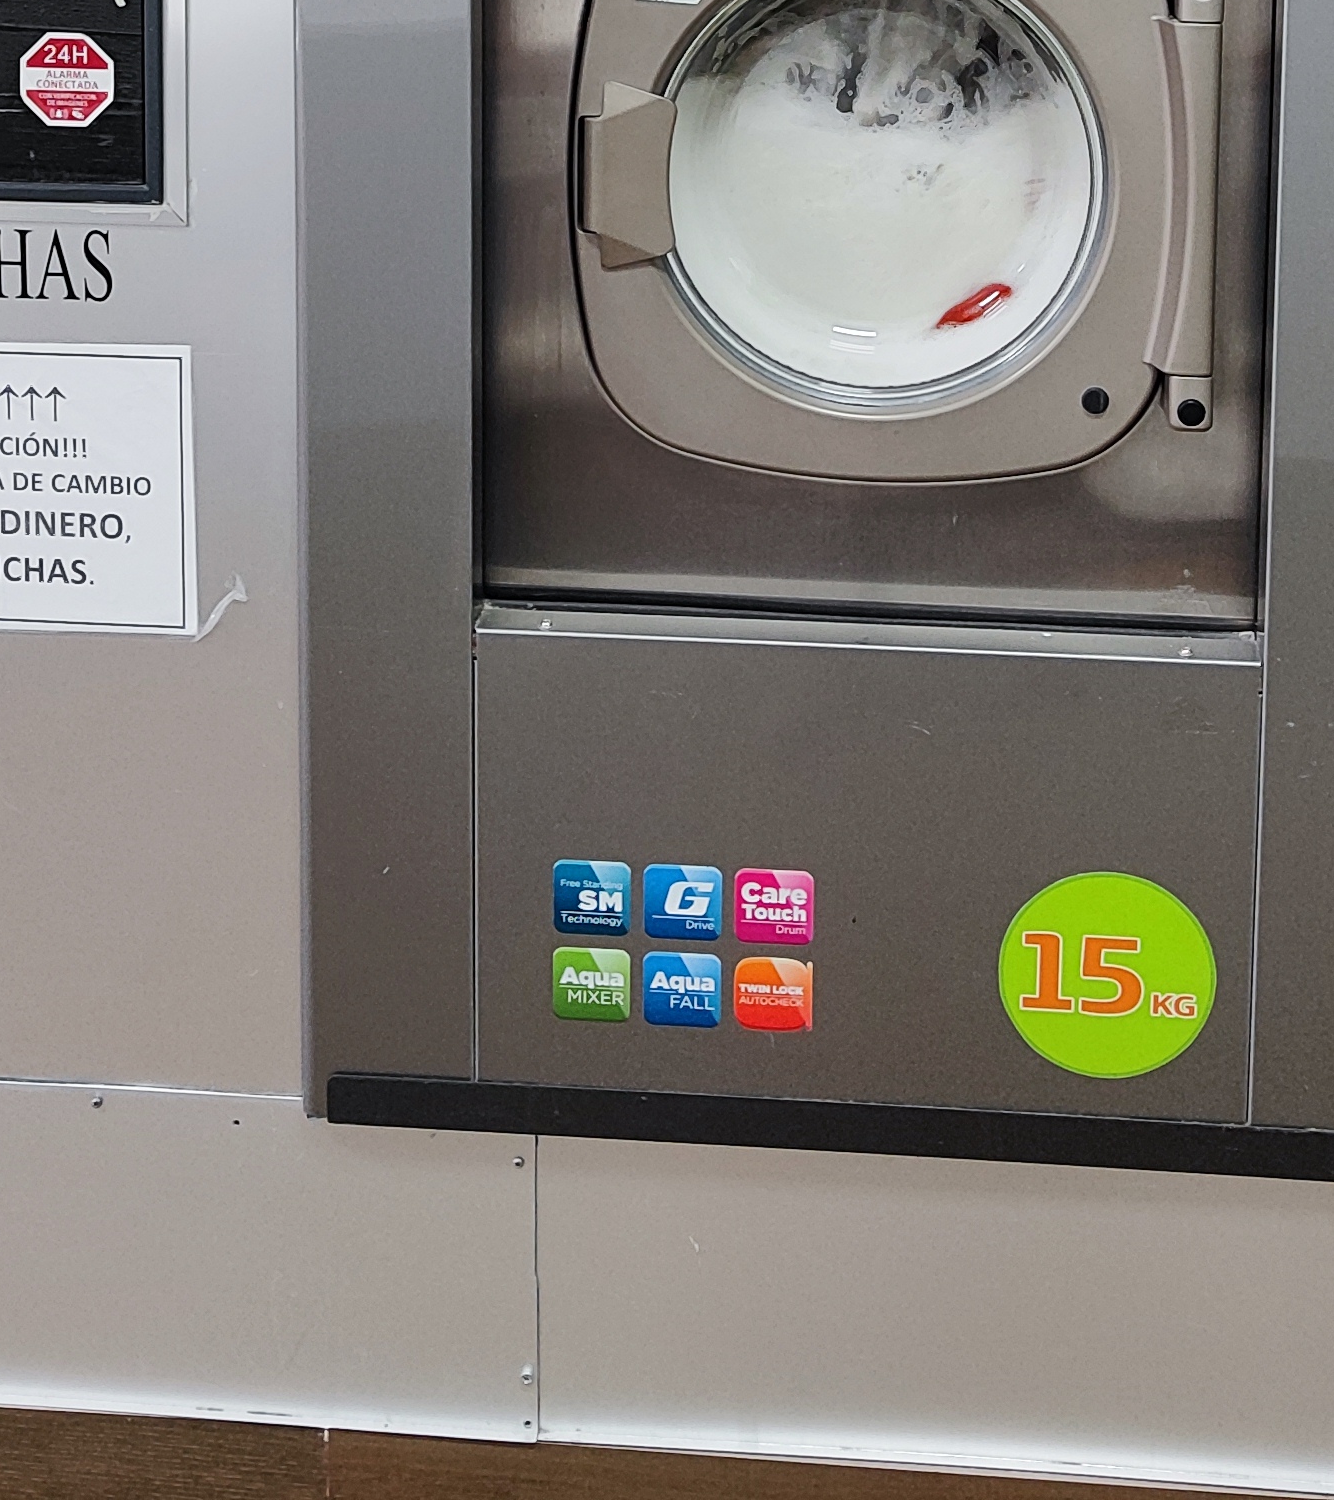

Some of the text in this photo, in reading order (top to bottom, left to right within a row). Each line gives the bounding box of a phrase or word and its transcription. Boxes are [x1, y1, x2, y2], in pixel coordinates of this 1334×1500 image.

[44, 45, 87, 64] 24H
[37, 80, 98, 89] CONECTADA
[13, 473, 42, 491] DE
[52, 474, 151, 495] CAMBIO
[1, 510, 130, 543] DINERO,
[560, 912, 624, 928] Technology
[559, 967, 624, 990] Aqua
[1020, 930, 1197, 1018] 15 KG
[567, 989, 624, 1006] MIXER
